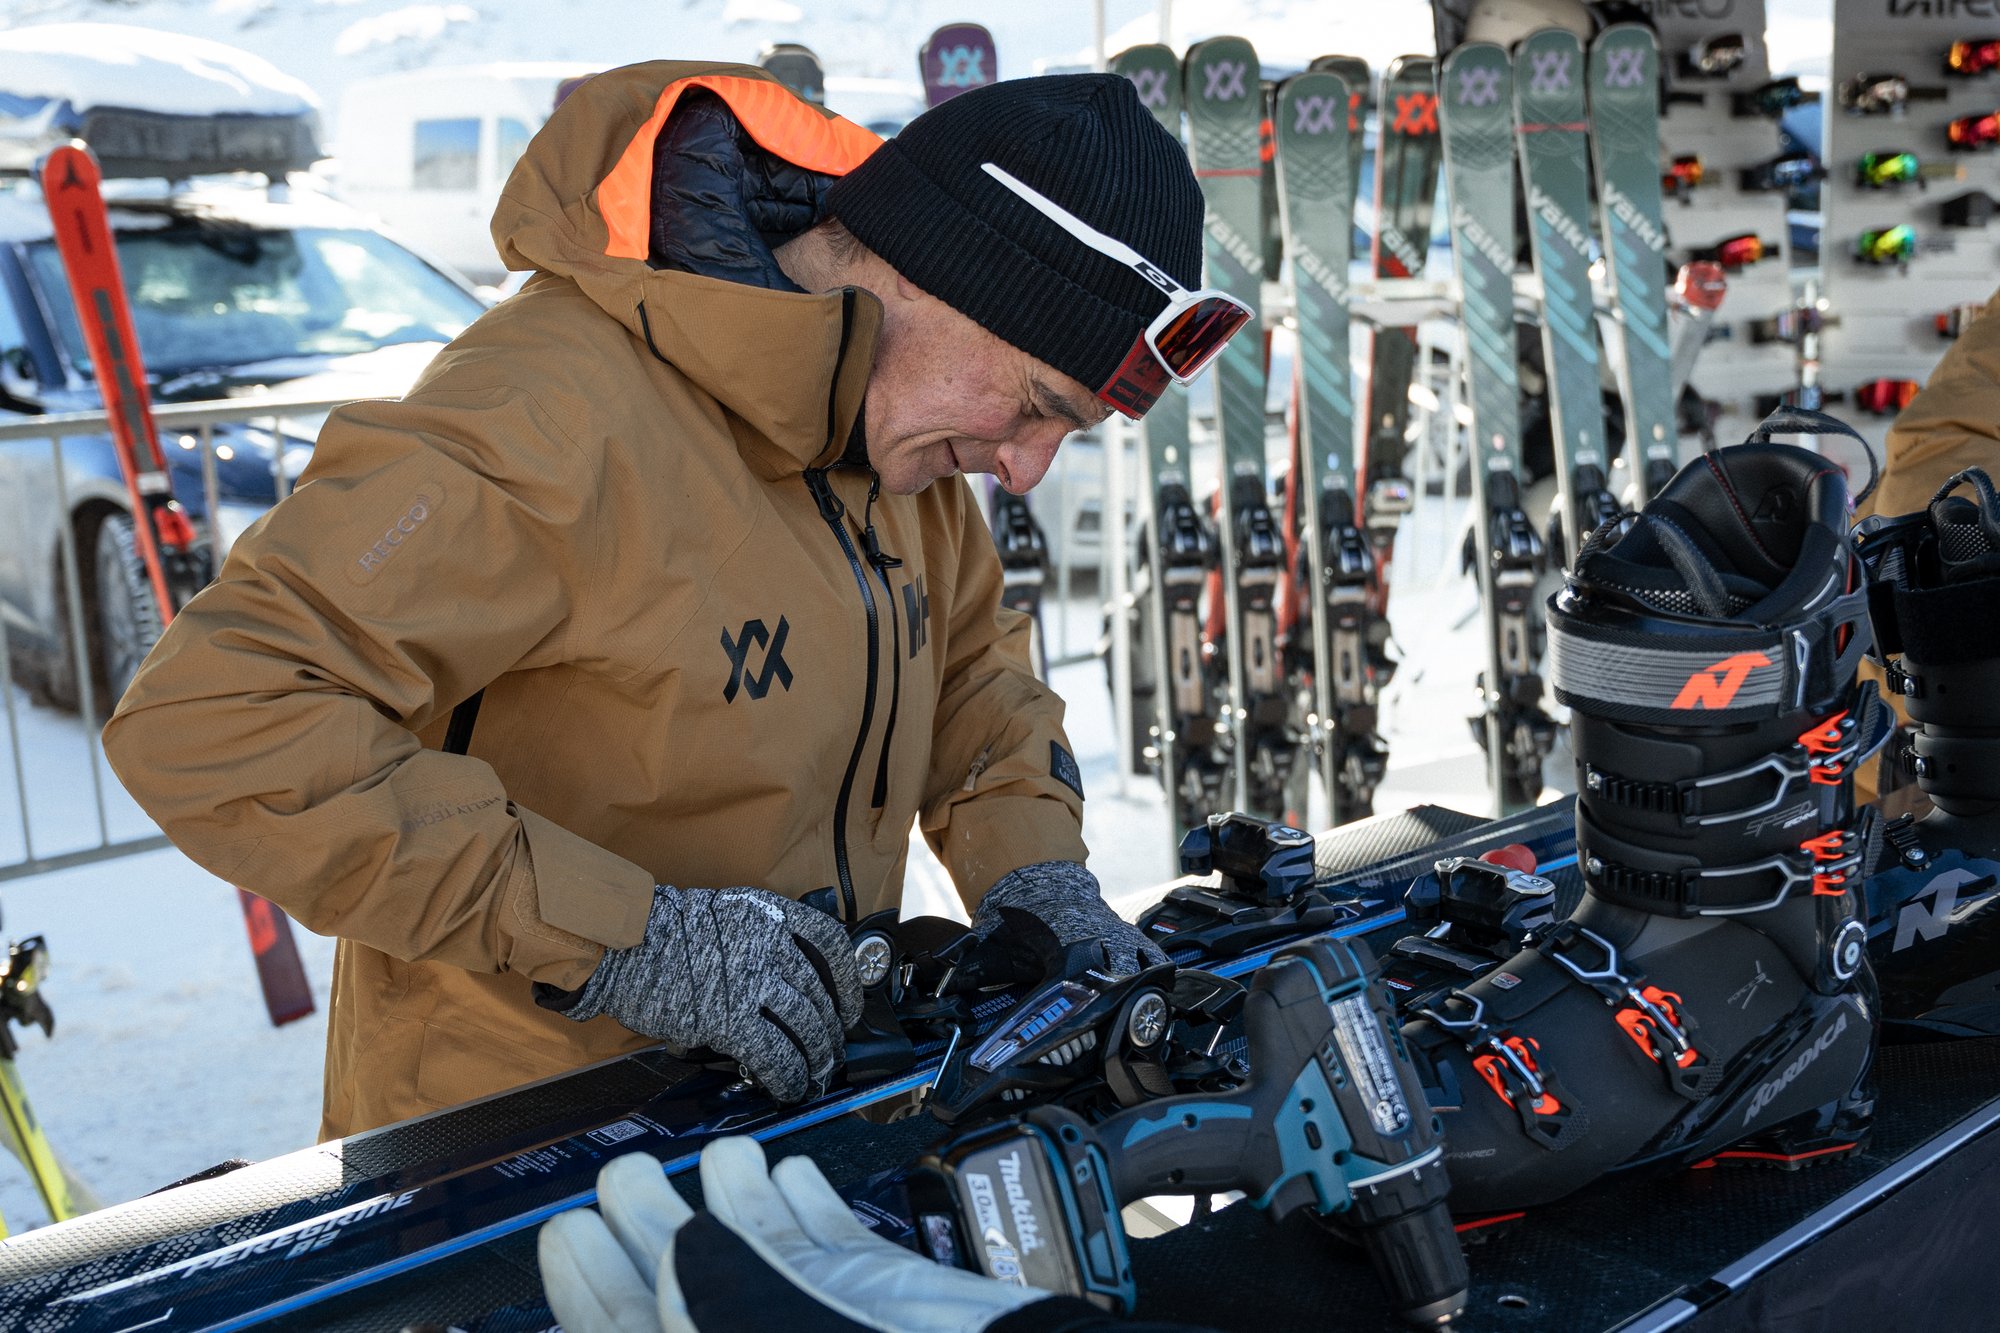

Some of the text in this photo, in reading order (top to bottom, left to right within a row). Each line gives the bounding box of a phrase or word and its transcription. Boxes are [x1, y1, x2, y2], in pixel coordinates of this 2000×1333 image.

[357, 503, 428, 574] RECCO
[1741, 1011, 1848, 1128] NORDICA
[180, 1187, 424, 1280] PEREGRINE
